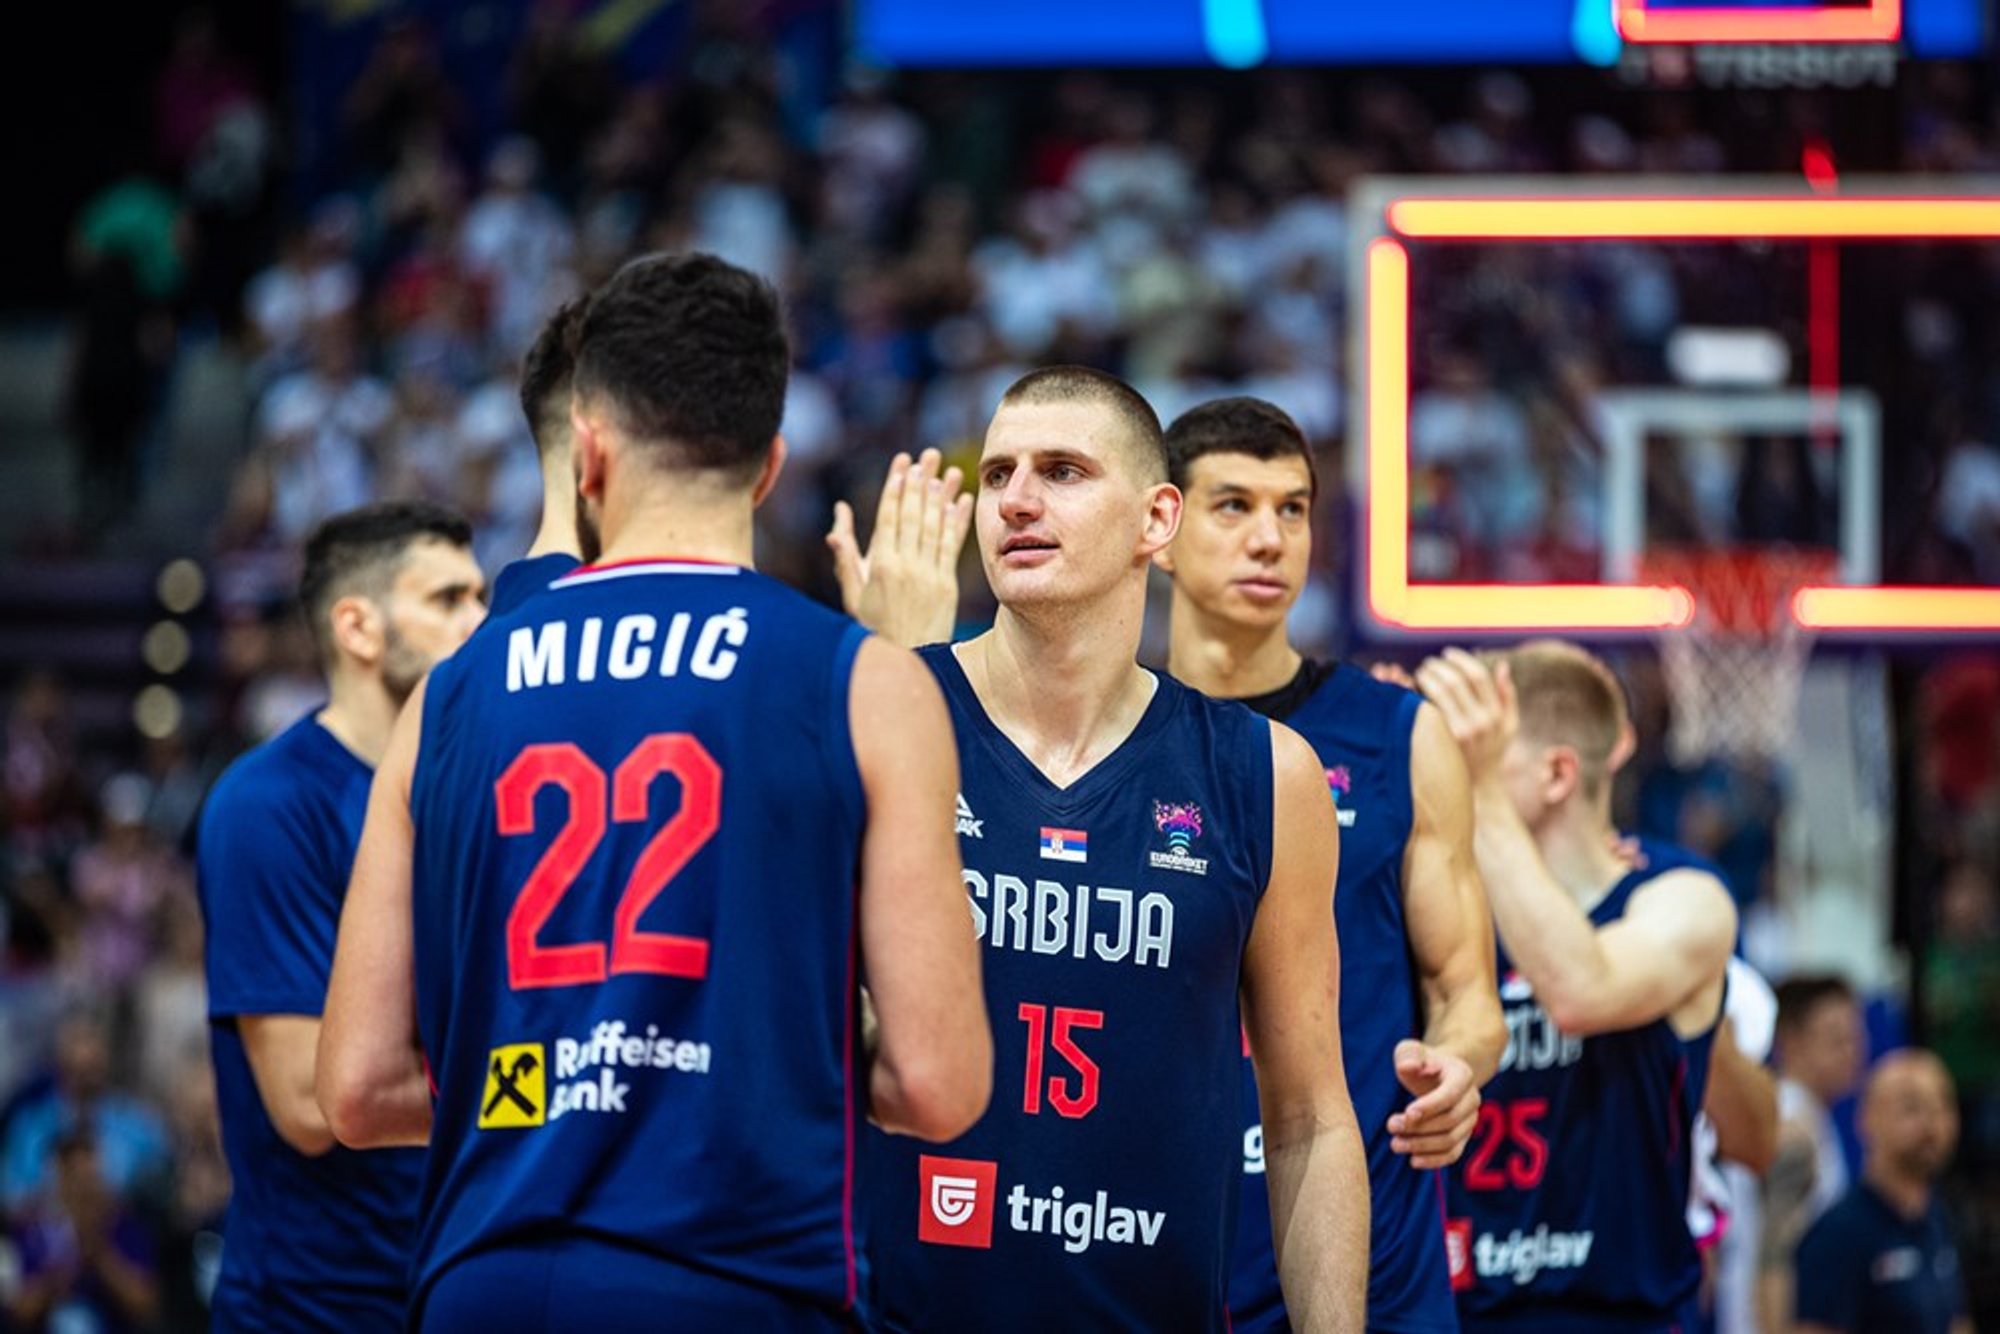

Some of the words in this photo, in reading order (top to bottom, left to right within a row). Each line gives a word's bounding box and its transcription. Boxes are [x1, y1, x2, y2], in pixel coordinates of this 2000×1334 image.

[506, 607, 748, 692] MICIĆ
[494, 732, 723, 989] 22
[956, 818, 984, 839] AK
[1018, 1002, 1104, 1118] 15
[1465, 1098, 1549, 1190] 25
[1007, 1184, 1166, 1254] triglav
[1473, 1222, 1595, 1285] triglav
